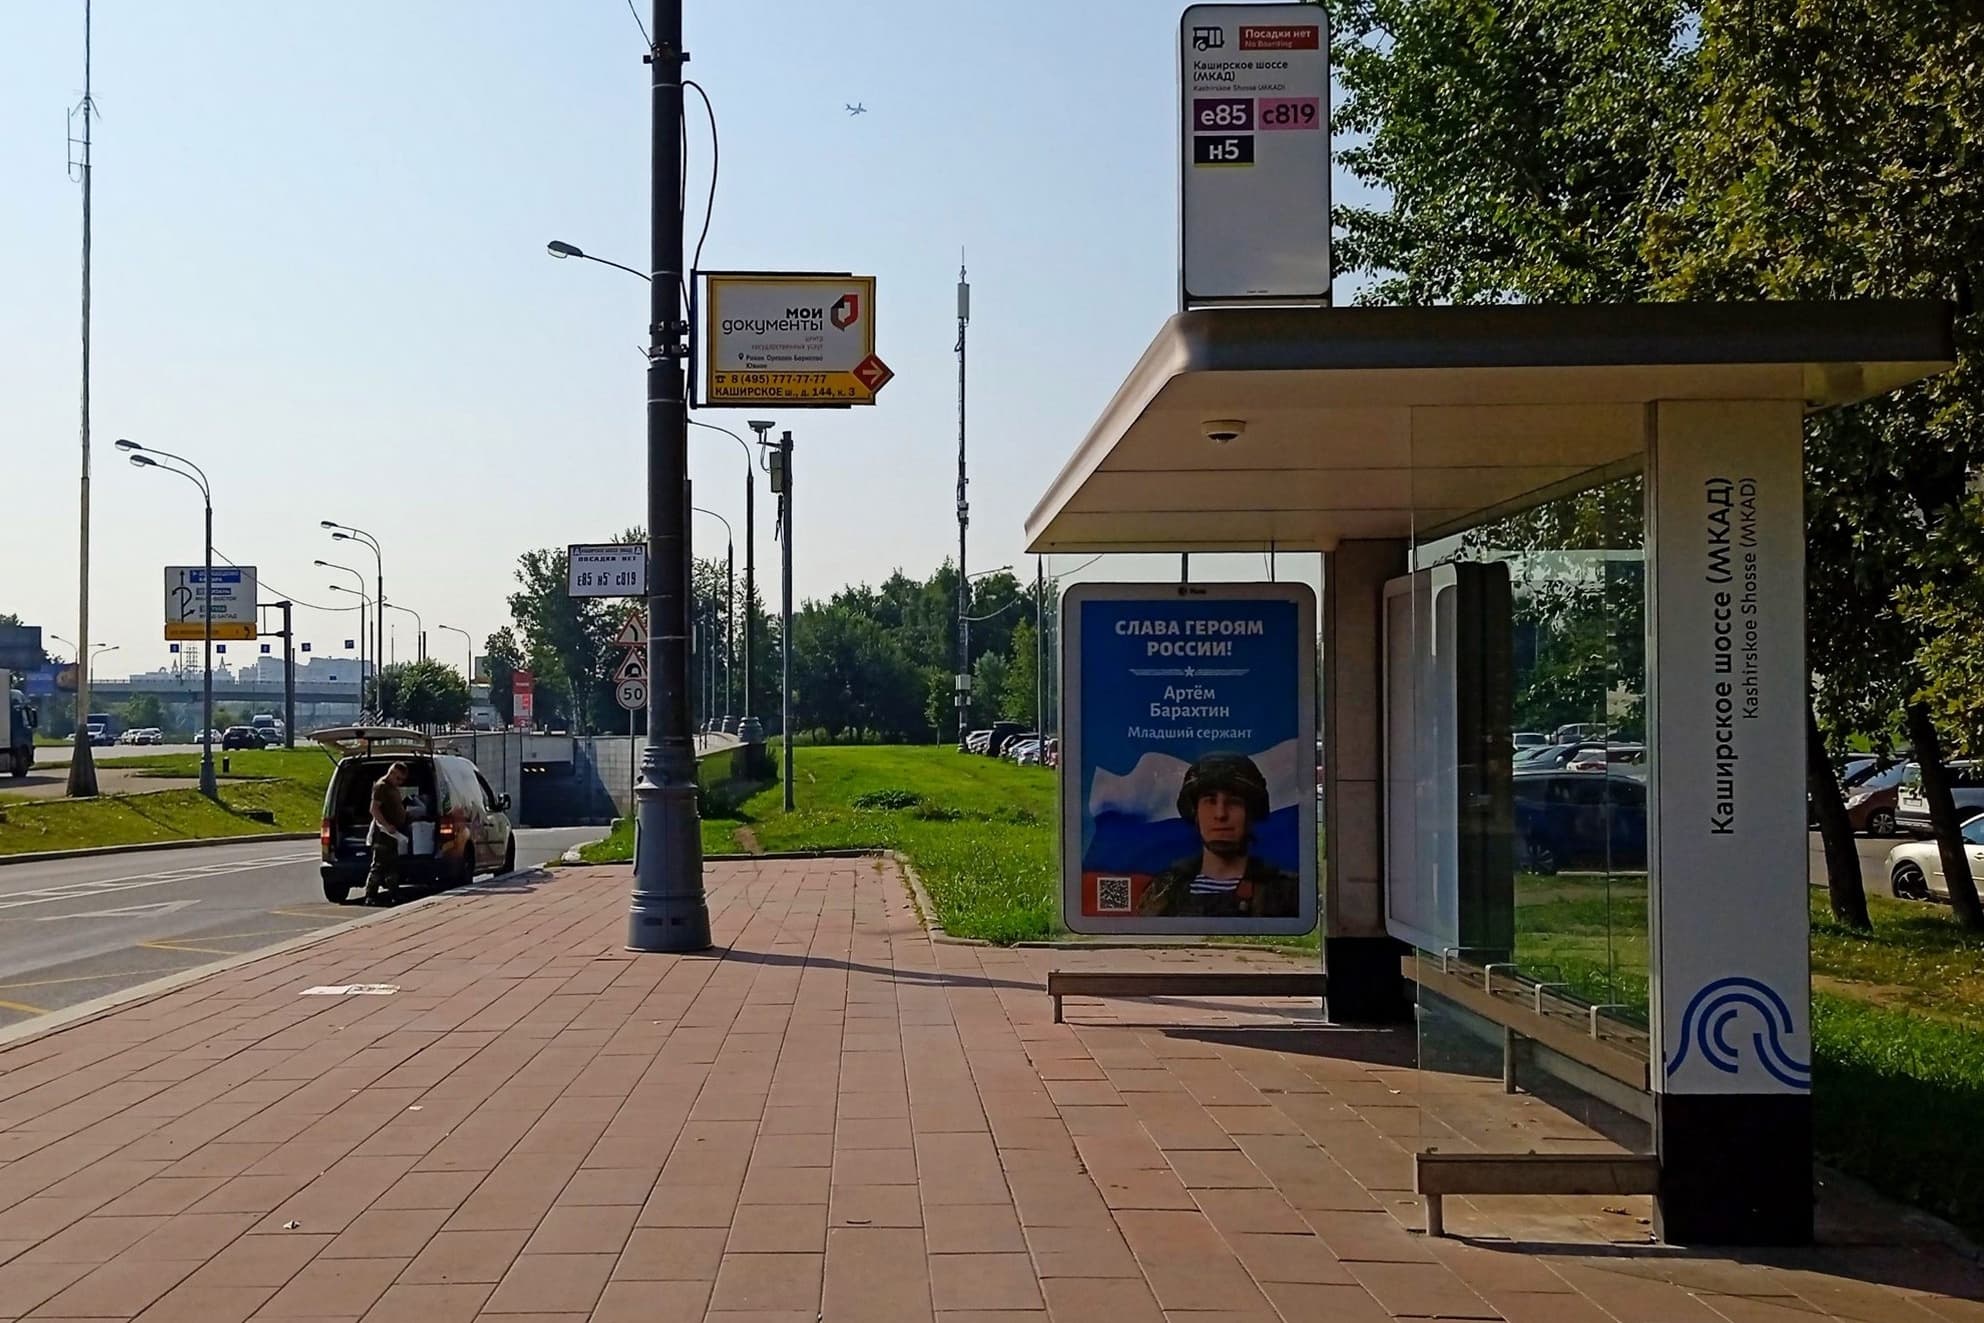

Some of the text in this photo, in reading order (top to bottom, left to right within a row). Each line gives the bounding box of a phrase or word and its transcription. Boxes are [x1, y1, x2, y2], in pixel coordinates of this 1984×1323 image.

[1245, 29, 1312, 39] Посадки нет
[1193, 61, 1253, 70] Каширское
[1193, 71, 1236, 81] (МКАД)
[1262, 103, 1316, 125] с819
[1209, 139, 1240, 160] н5
[785, 307, 823, 319] мои
[722, 319, 823, 335] документы
[731, 374, 827, 385] 8 (495) 777-77-77
[715, 387, 783, 397] КАШИРСКОЕ
[812, 387, 835, 398] 144,
[848, 387, 856, 397] 3
[1738, 477, 1759, 719] Kashirskoe Shosse (MKAD)
[1115, 620, 1264, 636] СЛАВА ГЕРОЯМ
[1147, 641, 1233, 657] РОССИИ!
[1705, 477, 1738, 835] Каширское шоссе (МКАД)
[624, 687, 643, 701] 50
[1163, 684, 1216, 703] Артём
[1150, 703, 1230, 720] Барахтин
[1128, 725, 1252, 741] Младший сержант
